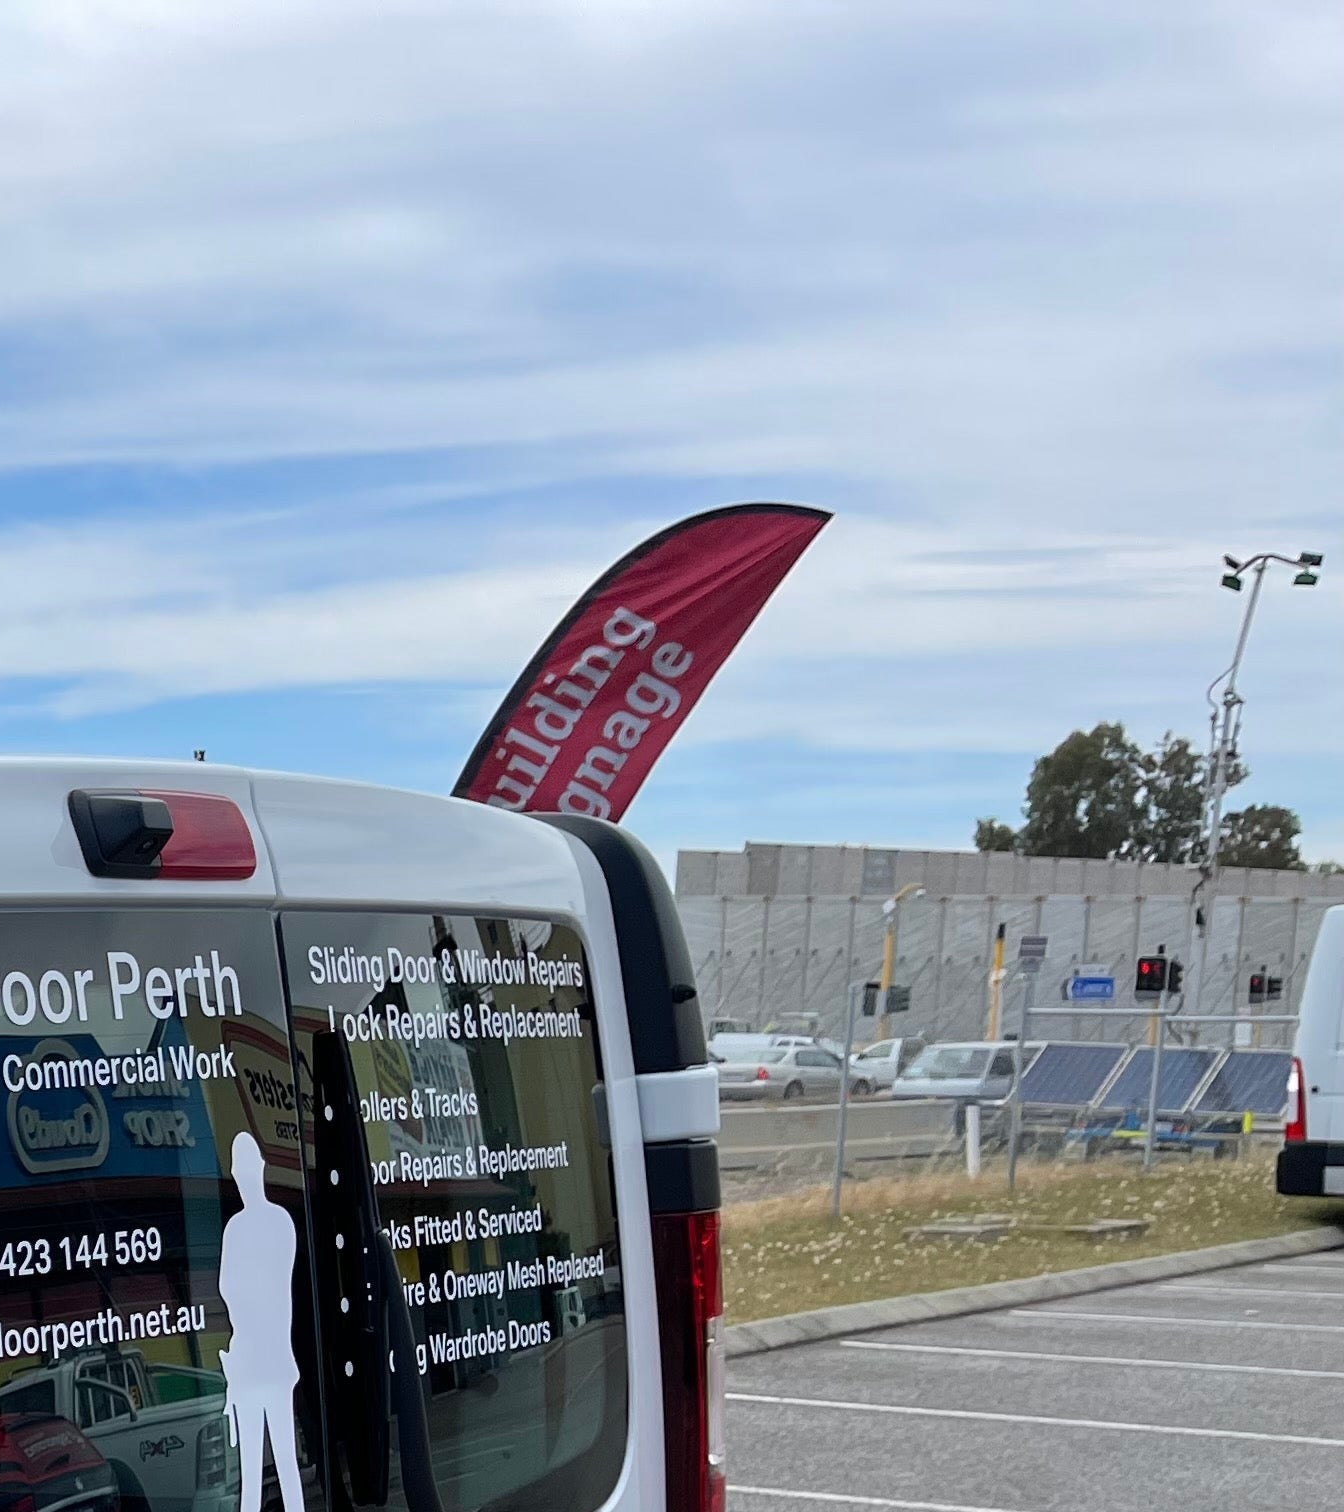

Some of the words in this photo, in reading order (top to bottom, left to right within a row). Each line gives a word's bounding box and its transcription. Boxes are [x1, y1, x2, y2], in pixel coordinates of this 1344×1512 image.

[486, 606, 658, 812] uilding
[557, 641, 695, 820] gnage
[107, 949, 243, 1020] Perth
[308, 946, 385, 993] Sliding
[387, 947, 436, 984] Door
[441, 948, 456, 983] &
[457, 949, 526, 986] Window
[527, 951, 583, 993] Repairs
[386, 1005, 460, 1048] Repairs
[463, 1005, 478, 1038] &
[479, 1003, 583, 1045] Replacement
[2, 1050, 165, 1092] Commercial
[170, 1043, 237, 1080] Work
[360, 1090, 407, 1122] ollers
[411, 1089, 424, 1119] &
[424, 1086, 478, 1118] Tracks
[370, 1161, 397, 1186] oor
[400, 1146, 463, 1188] Repairs
[465, 1146, 477, 1175] &
[479, 1141, 569, 1179] Replacement
[414, 1212, 462, 1247] Fitted
[465, 1211, 477, 1240] &
[479, 1203, 542, 1238] Serviced
[59, 1233, 109, 1271] 144
[115, 1227, 162, 1266] 569
[429, 1273, 440, 1302] &
[444, 1267, 505, 1302] Oneway
[507, 1261, 546, 1291] Mesh
[547, 1248, 604, 1285] Replaced
[429, 1326, 506, 1364] Wardrobe
[508, 1319, 551, 1350] Doors
